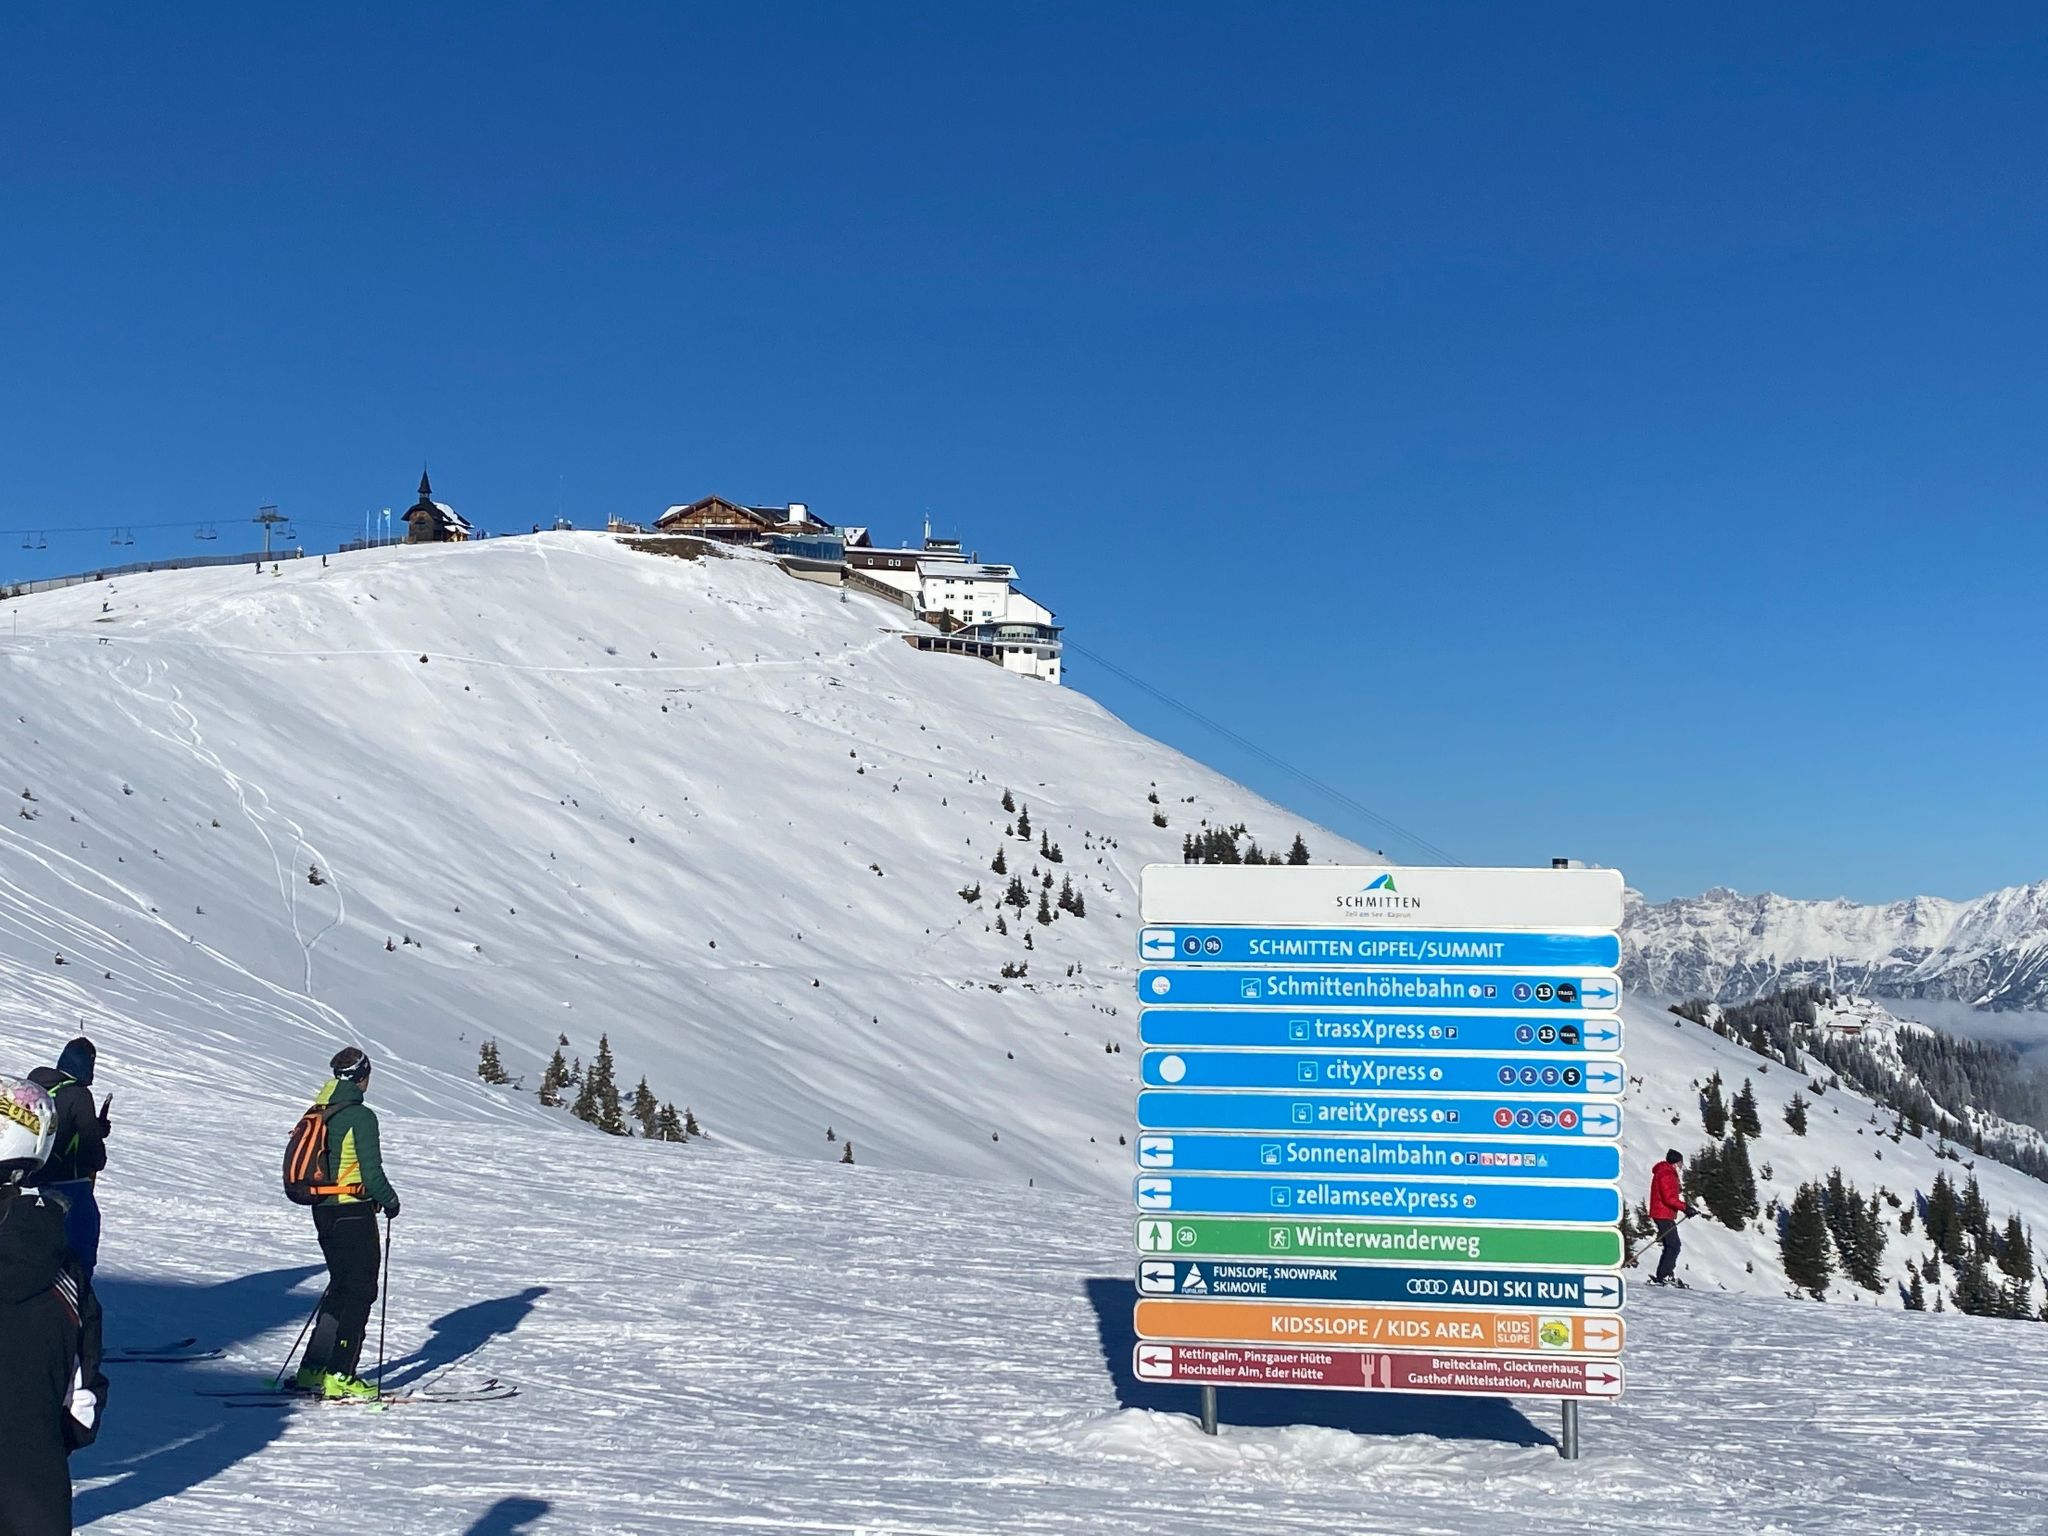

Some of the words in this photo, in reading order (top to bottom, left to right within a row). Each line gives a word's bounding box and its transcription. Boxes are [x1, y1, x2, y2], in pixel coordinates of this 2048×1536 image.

[1336, 896, 1421, 908] SCHMITTEN
[1206, 940, 1220, 951] 9b
[1249, 940, 1352, 956] SCHMITTEN
[1358, 941, 1504, 960] GIPFEL/SUMMIT
[1267, 975, 1464, 998] Schmittenhöhebahn
[1538, 988, 1551, 998] 13
[1315, 1018, 1425, 1044] trassXpress
[1540, 1029, 1554, 1039] 13
[1327, 1059, 1425, 1085] cityXpress
[1319, 1102, 1427, 1128] areitXpress
[1540, 1113, 1553, 1124] 3a
[1287, 1143, 1446, 1165] Sonnenalmbahn
[1297, 1184, 1458, 1213] zellamseeXpress
[1180, 1231, 1193, 1241] 28
[1296, 1226, 1480, 1257] Winterwanderweg
[1214, 1266, 1271, 1280] FUNSLOPE,
[1274, 1267, 1337, 1280] SNOWPARK
[1214, 1281, 1267, 1294] SKIMOVIE
[1452, 1279, 1498, 1297] AUDI
[1504, 1281, 1532, 1298] SKI
[1538, 1283, 1579, 1299] RUN
[1272, 1316, 1368, 1335] KIDSSLOPE
[1388, 1321, 1430, 1337] KIDS
[1435, 1322, 1484, 1339] AREA
[1497, 1321, 1530, 1333] KIDS
[1497, 1333, 1530, 1344] SLOPE
[1179, 1349, 1242, 1363] Kettingalm,
[1245, 1351, 1298, 1364] Pinzgauer
[1300, 1352, 1332, 1364] Hütte
[1179, 1364, 1236, 1376] Hochzeller
[1238, 1367, 1263, 1379] Alm,
[1265, 1368, 1290, 1378] Eder
[1292, 1368, 1323, 1379] Hütte
[1433, 1359, 1500, 1373] Breiteckalm,
[1503, 1362, 1582, 1376] Glocknerhaus,
[1408, 1374, 1452, 1384] Gasthof
[1454, 1375, 1530, 1389] Mittelstation,
[1533, 1378, 1582, 1390] AreitAlm
